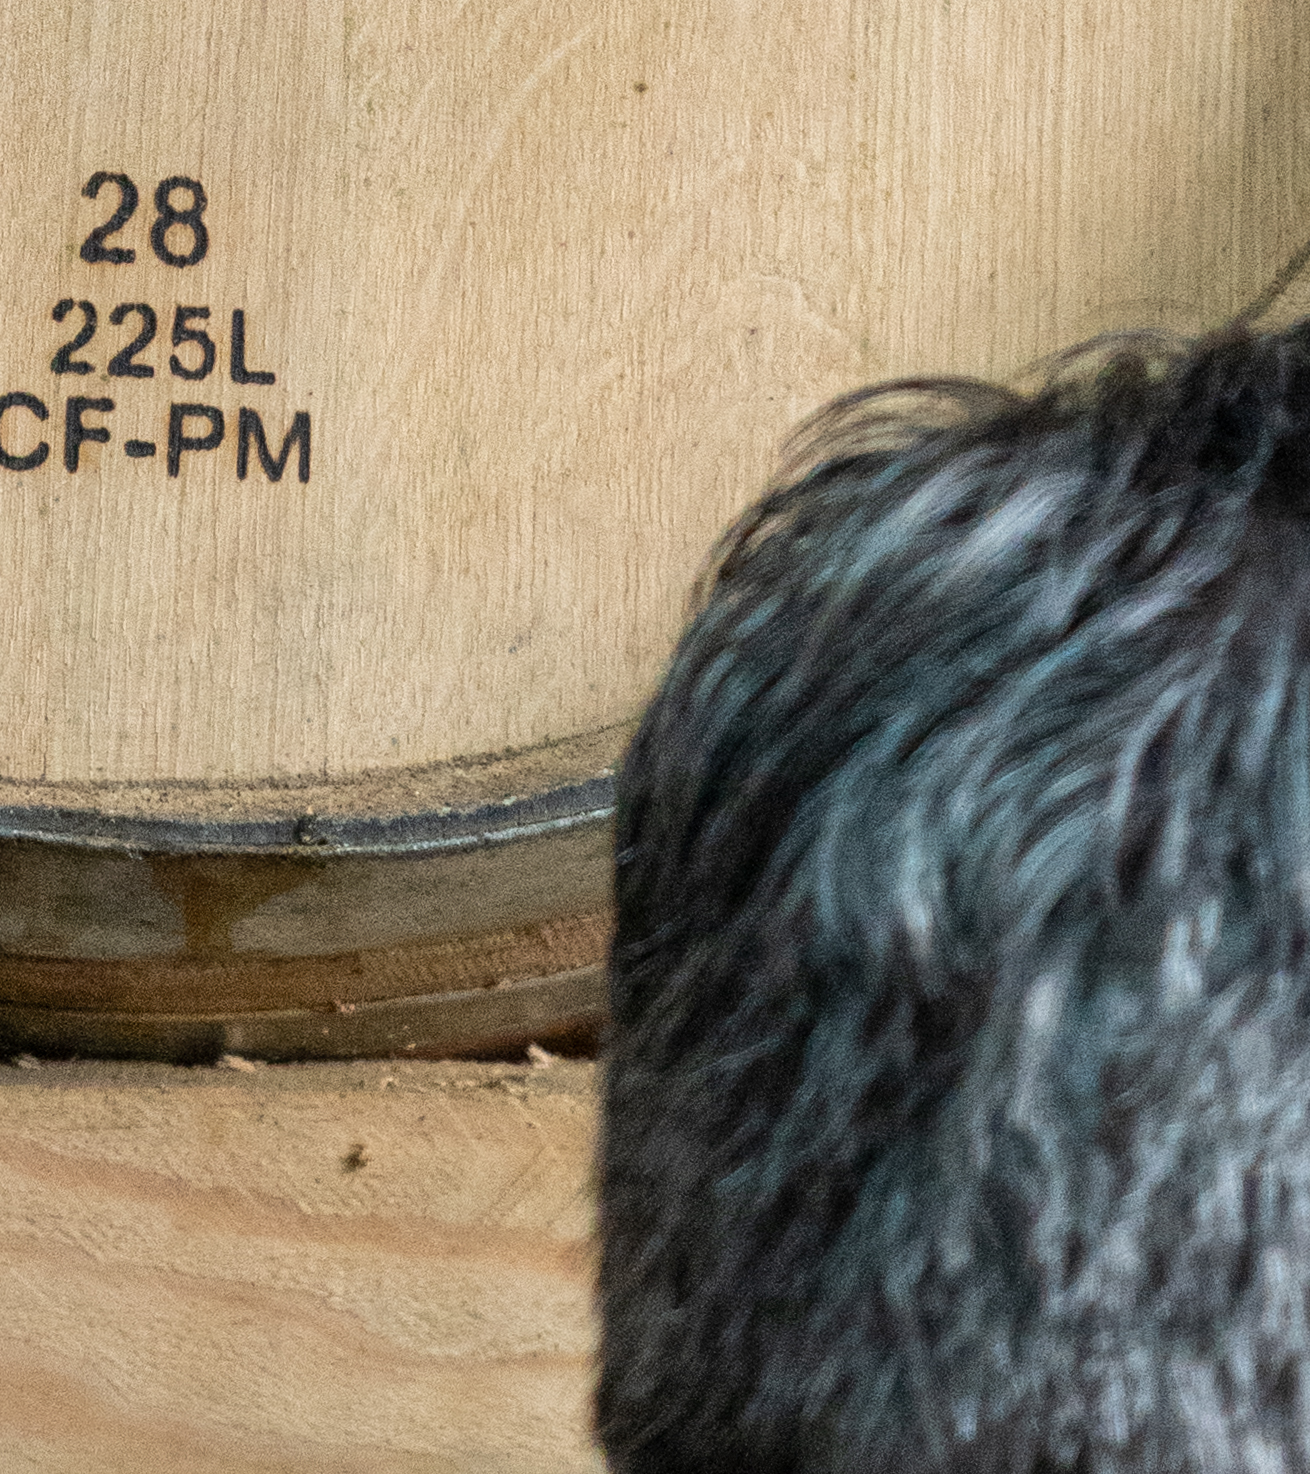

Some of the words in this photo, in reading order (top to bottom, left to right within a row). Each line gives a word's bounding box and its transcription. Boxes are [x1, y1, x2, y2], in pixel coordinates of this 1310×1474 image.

[80, 172, 209, 268] 28
[51, 299, 275, 384] 225L
[0, 391, 311, 483] CF-PM
